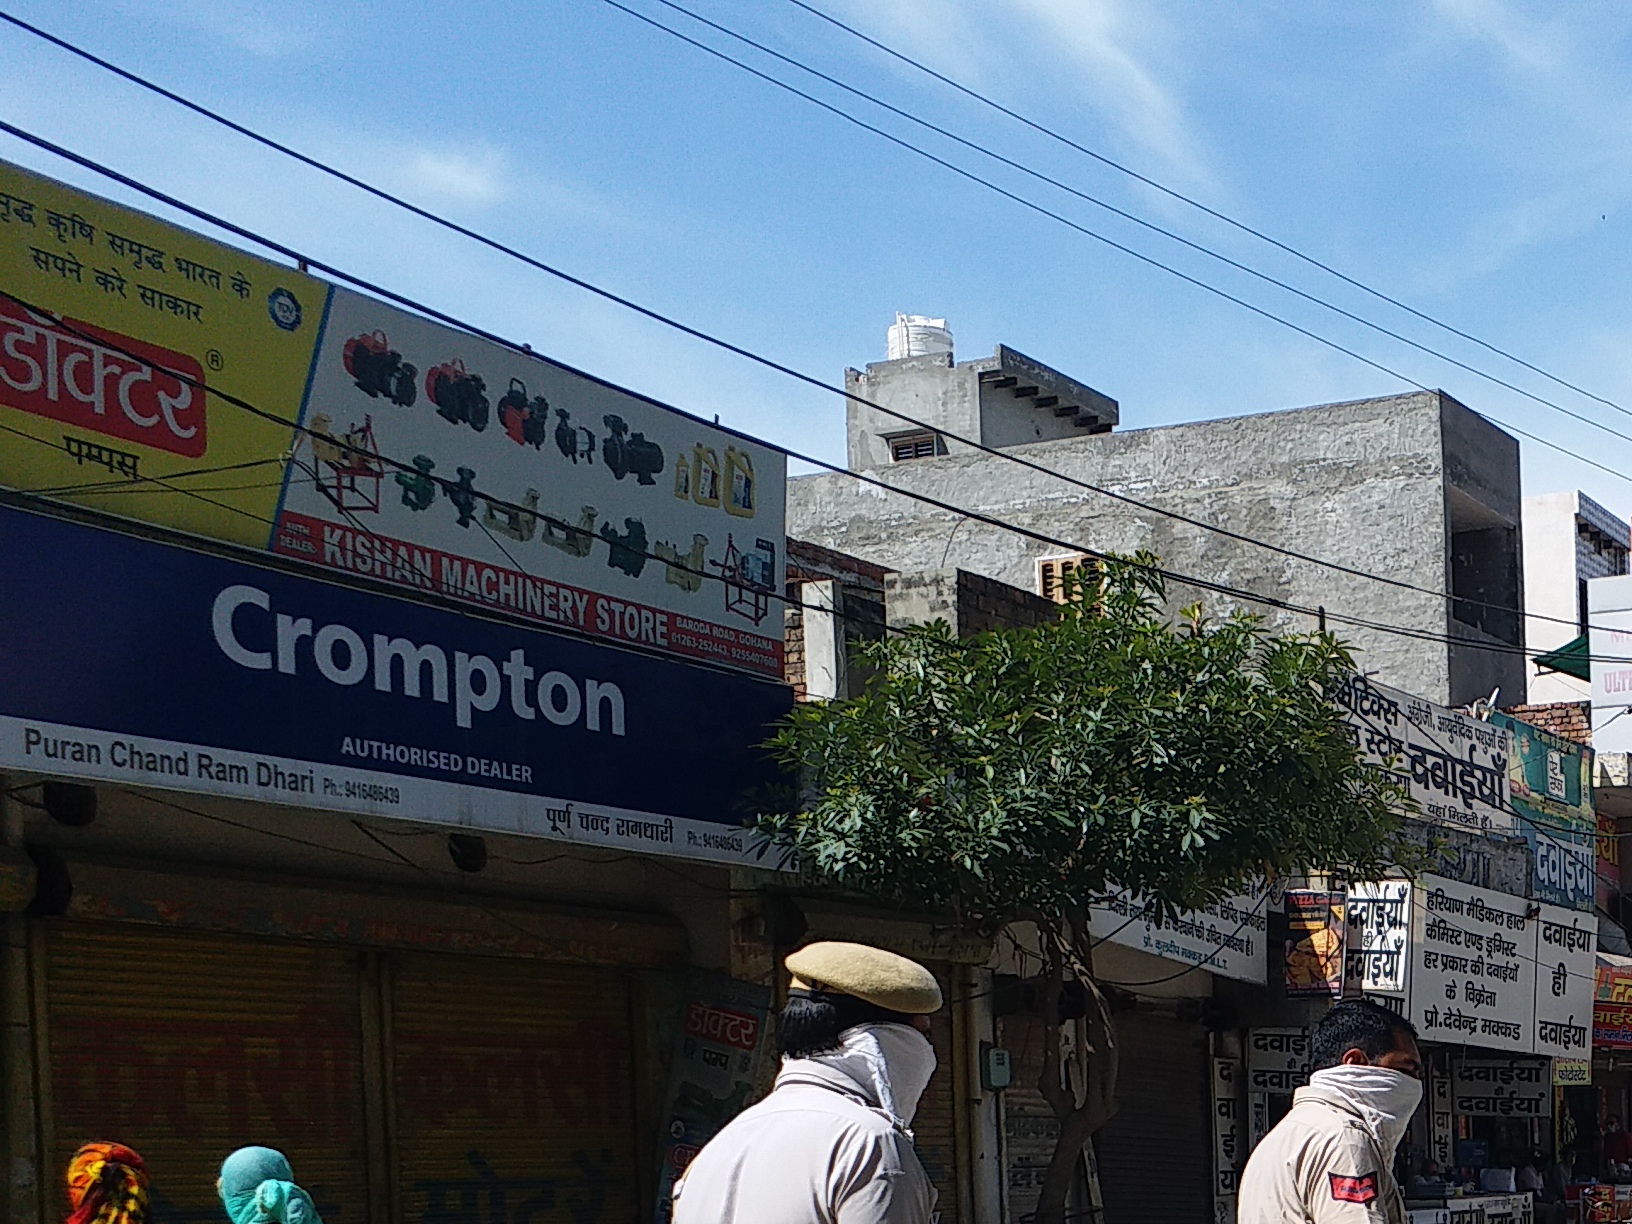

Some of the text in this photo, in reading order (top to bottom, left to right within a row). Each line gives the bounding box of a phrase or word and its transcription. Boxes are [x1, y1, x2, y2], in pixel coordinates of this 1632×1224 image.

[45, 208, 95, 246] कृषि
[174, 256, 222, 291] भारत
[230, 270, 251, 299] के
[29, 246, 203, 324] सपने करे साकार
[323, 525, 669, 648] KISHAN MACHINERY STORE
[676, 616, 710, 635] BARODA
[739, 634, 773, 652] GOHANA
[211, 583, 627, 737] Crompton
[24, 727, 100, 764] Puran
[109, 740, 189, 777] Chand
[197, 753, 249, 785] Ram
[256, 762, 315, 794] Dhari
[340, 736, 533, 784] AUTHORISED DEALER
[1408, 743, 1507, 810] दवाईयाँ
[546, 804, 571, 835] पूर्ण
[578, 812, 610, 834] चन्द
[1289, 895, 1315, 906] PIZZA
[1466, 896, 1504, 927] मैडिकल
[1506, 911, 1525, 932] हाल
[1425, 918, 1462, 946] कैमिस्ट
[1464, 931, 1483, 952] एण्ड
[1424, 950, 1438, 970] हर
[1440, 953, 1469, 975] प्रकार
[1470, 954, 1484, 978] की
[1551, 962, 1567, 998] ही
[1445, 979, 1497, 1008] के विक्रेता
[688, 1001, 757, 1046] डॉक्टर
[1252, 1026, 1310, 1057] दवाई
[1457, 1061, 1546, 1085] दवाईयां
[1457, 1091, 1546, 1115] दवाईयां
